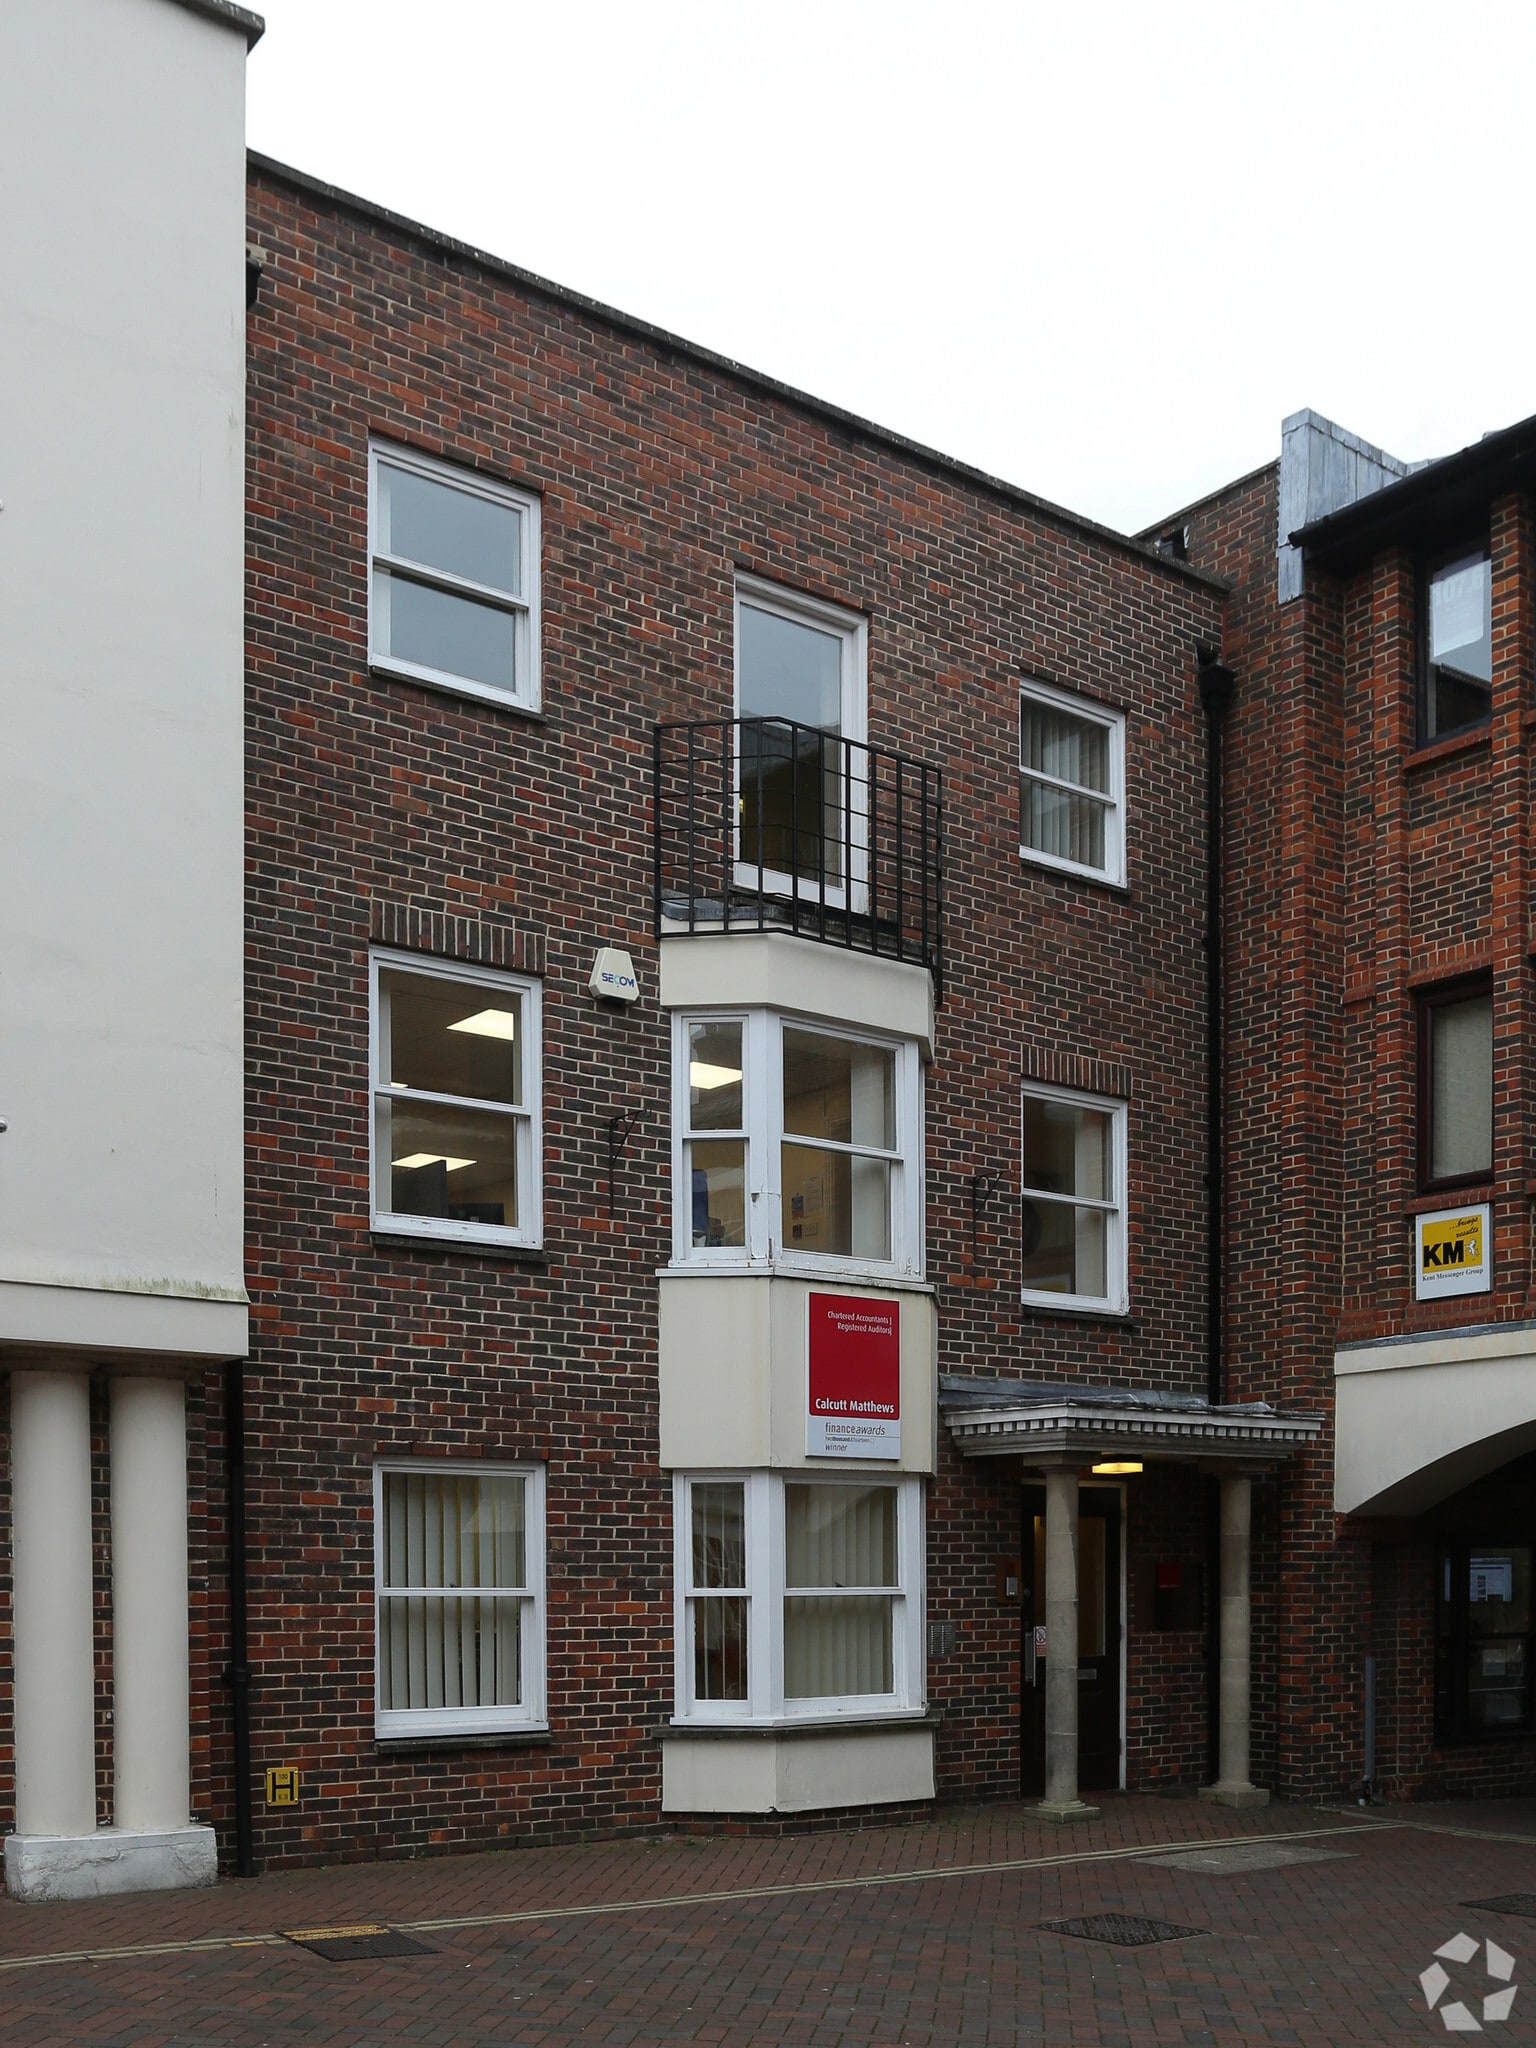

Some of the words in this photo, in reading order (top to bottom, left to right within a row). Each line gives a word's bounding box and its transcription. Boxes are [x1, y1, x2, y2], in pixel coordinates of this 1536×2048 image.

[602, 972, 635, 987] SECOM
[1423, 1240, 1464, 1268] KM
[1436, 1271, 1465, 1279] Messenger
[827, 1310, 855, 1320] Chartered
[856, 1314, 889, 1323] Accountants
[837, 1322, 867, 1332] Registered
[868, 1325, 890, 1335] Auditors
[815, 1398, 847, 1411] Calcutt
[850, 1400, 895, 1414] Matthews
[825, 1443, 848, 1452] winner
[272, 1771, 294, 1802] H
